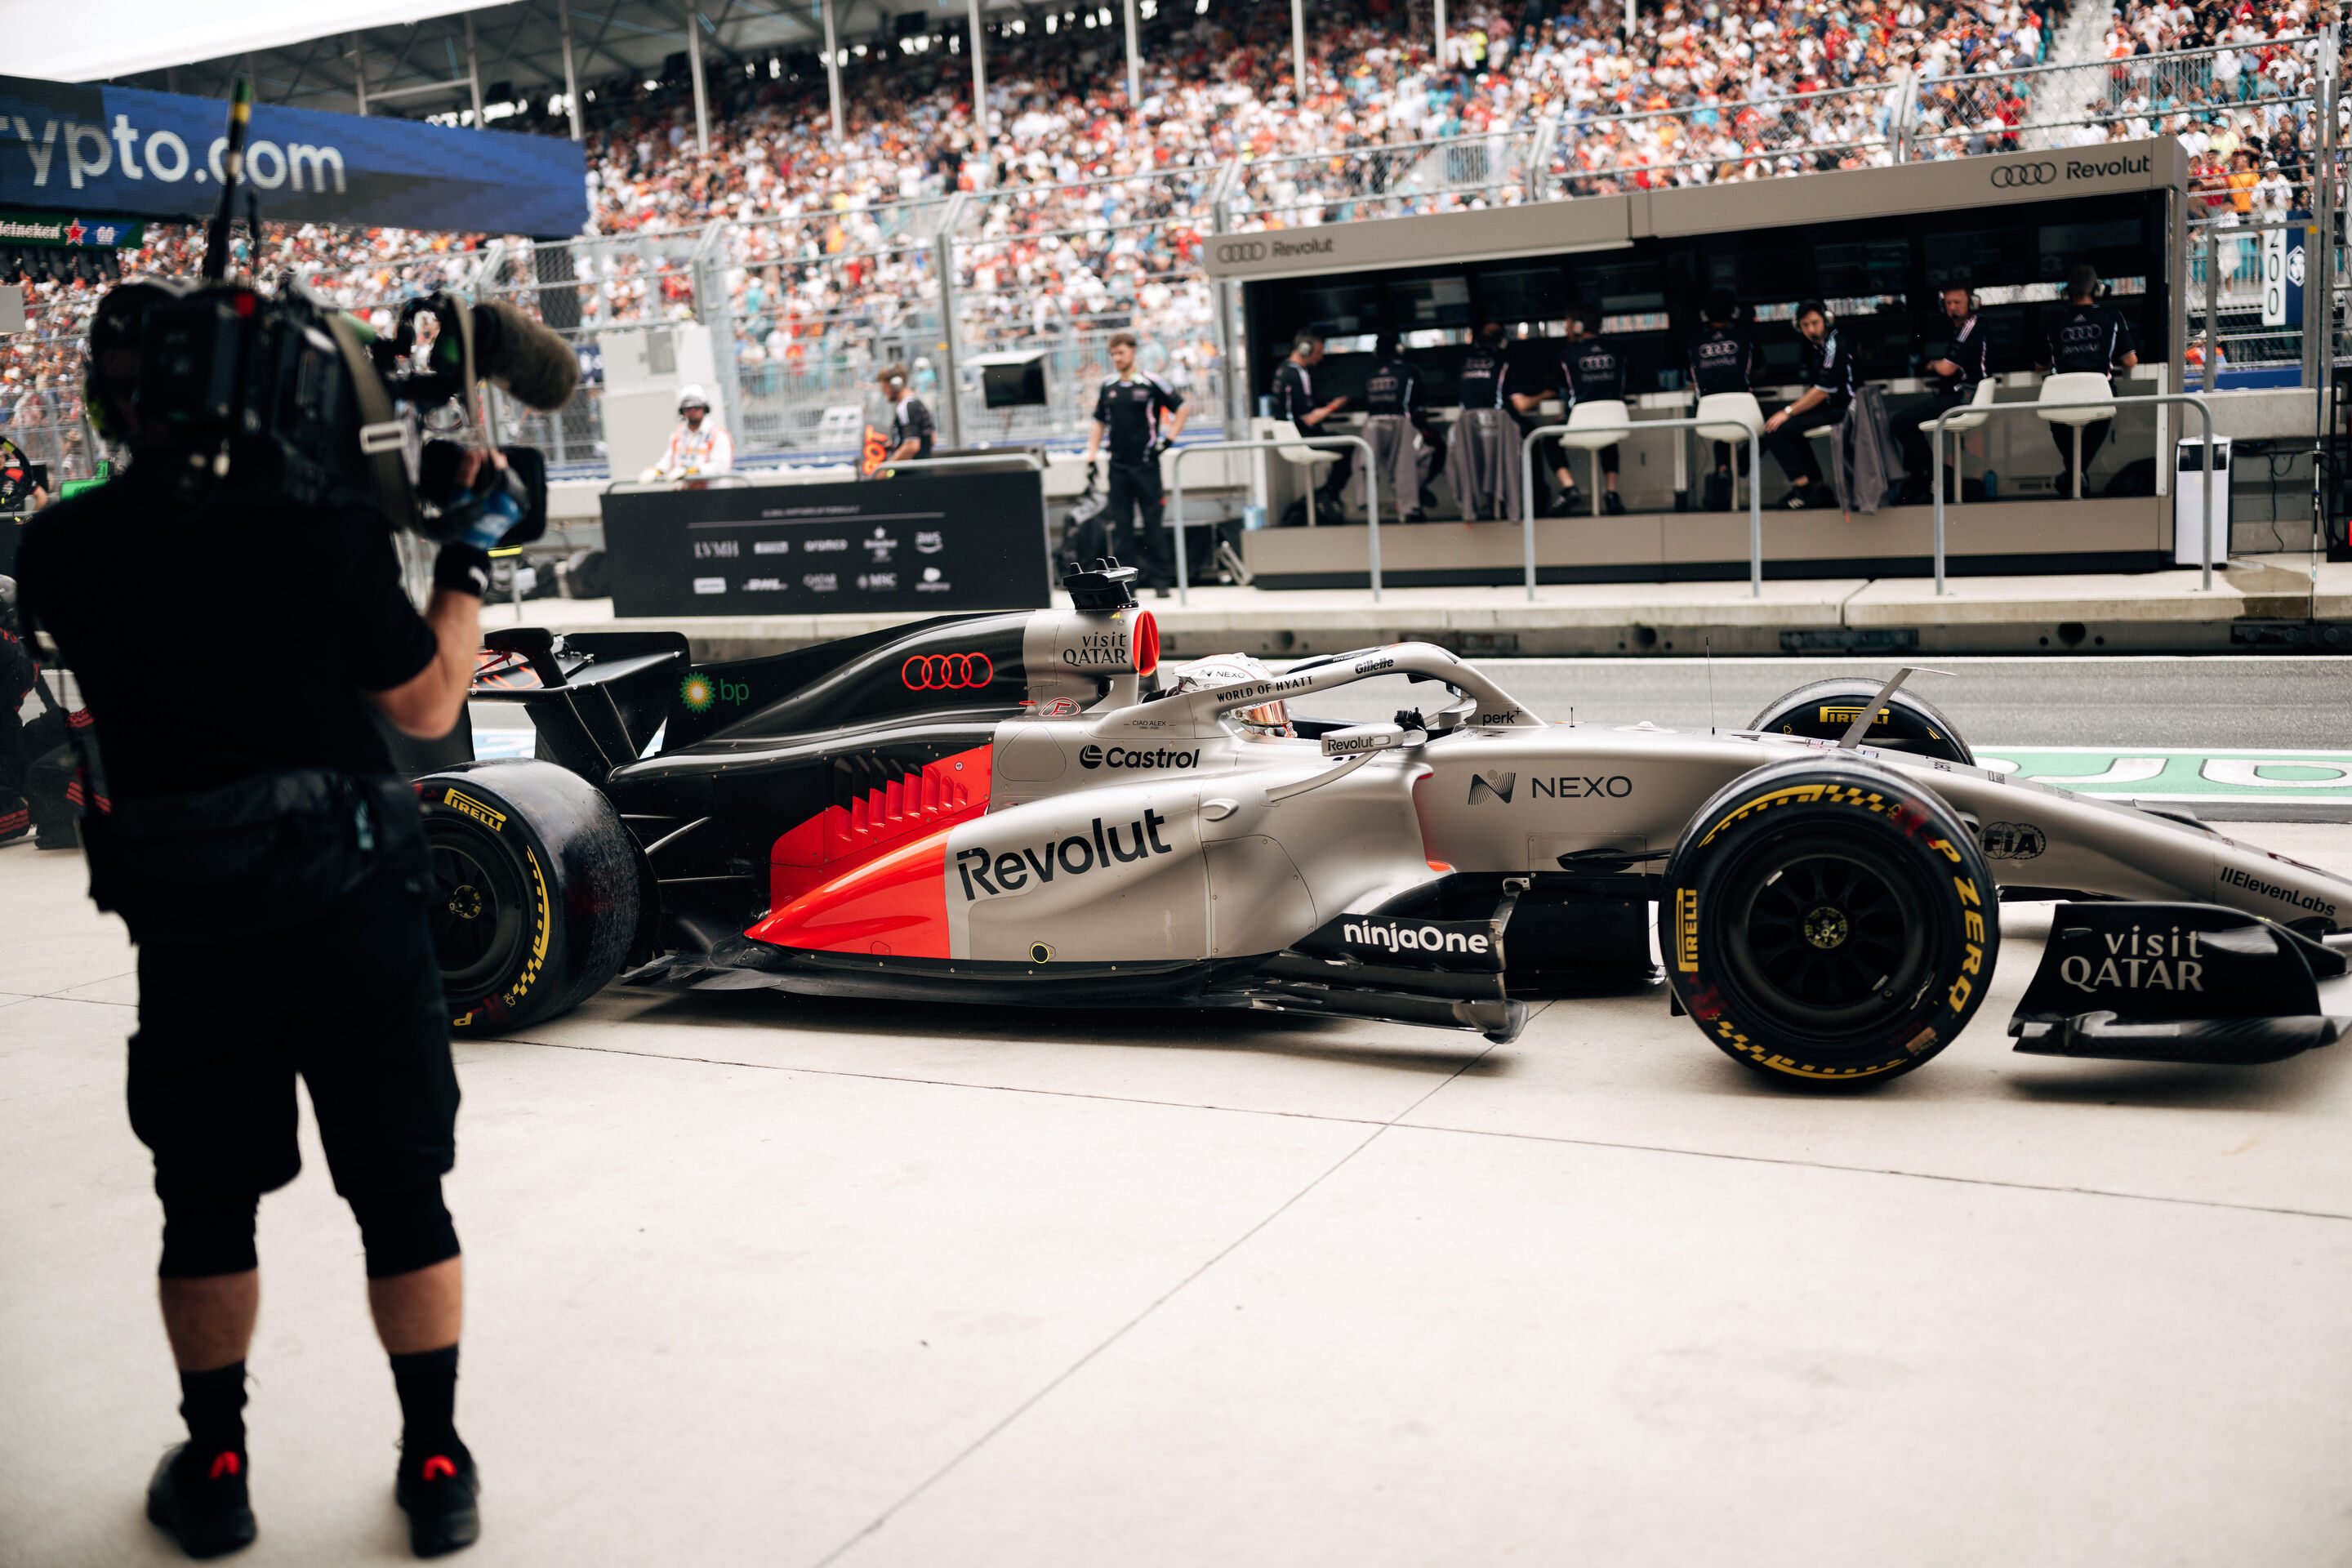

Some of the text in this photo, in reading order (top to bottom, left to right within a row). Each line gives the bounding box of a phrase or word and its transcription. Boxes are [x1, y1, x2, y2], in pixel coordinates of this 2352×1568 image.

[2066, 155, 2150, 180] Revolut
[1272, 237, 1334, 257] Revolut
[1082, 631, 1127, 647] visit
[1063, 648, 1127, 666] QATAR
[1355, 658, 1394, 675] Gillette
[719, 678, 750, 706] bp
[1217, 675, 1312, 703] WORLD OF HYATT
[1106, 746, 1200, 768] Castrol
[1328, 736, 1374, 751] Revolut
[1532, 776, 1633, 798] NEXO
[443, 787, 507, 832] PIRELLI
[956, 808, 1173, 902] Revolut
[1343, 920, 1489, 954] ninjaOne
[1676, 887, 1699, 973] PIRELLI
[2105, 924, 2203, 958] visit
[1949, 876, 1985, 1013] ZERO
[2060, 956, 2204, 993] QATAR
